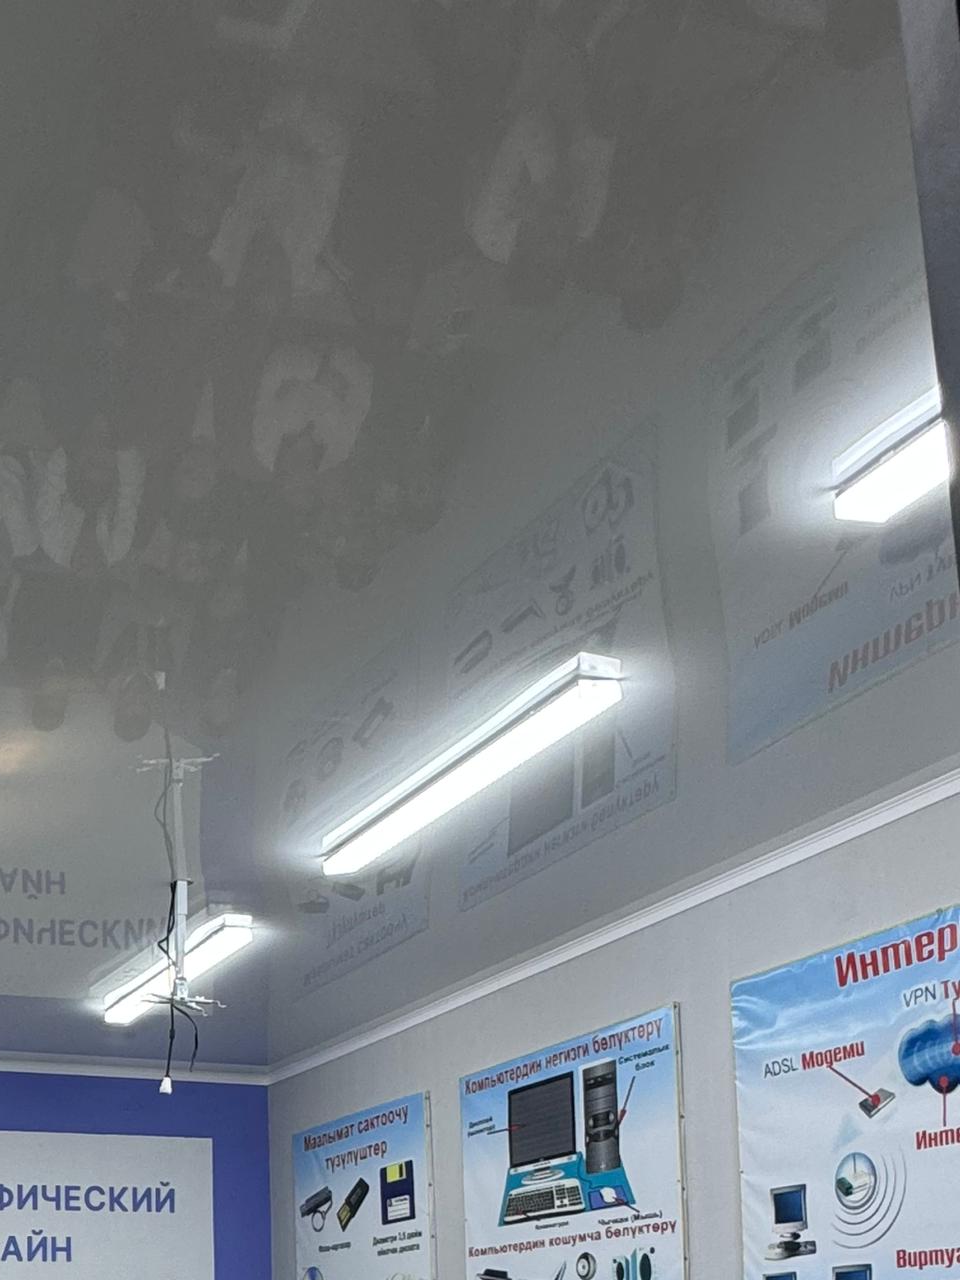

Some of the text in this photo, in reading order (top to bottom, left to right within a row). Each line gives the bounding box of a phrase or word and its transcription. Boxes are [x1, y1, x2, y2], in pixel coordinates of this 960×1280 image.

[903, 984, 937, 1008] VPN
[465, 1017, 664, 1095] Компьютердин негизги бөлүктөрү
[763, 1041, 865, 1079] ADSL Модеми
[304, 1104, 409, 1152] Маалымат сактоочу
[468, 1219, 677, 1258] Компьютердин кошумча бөлүктөрү
